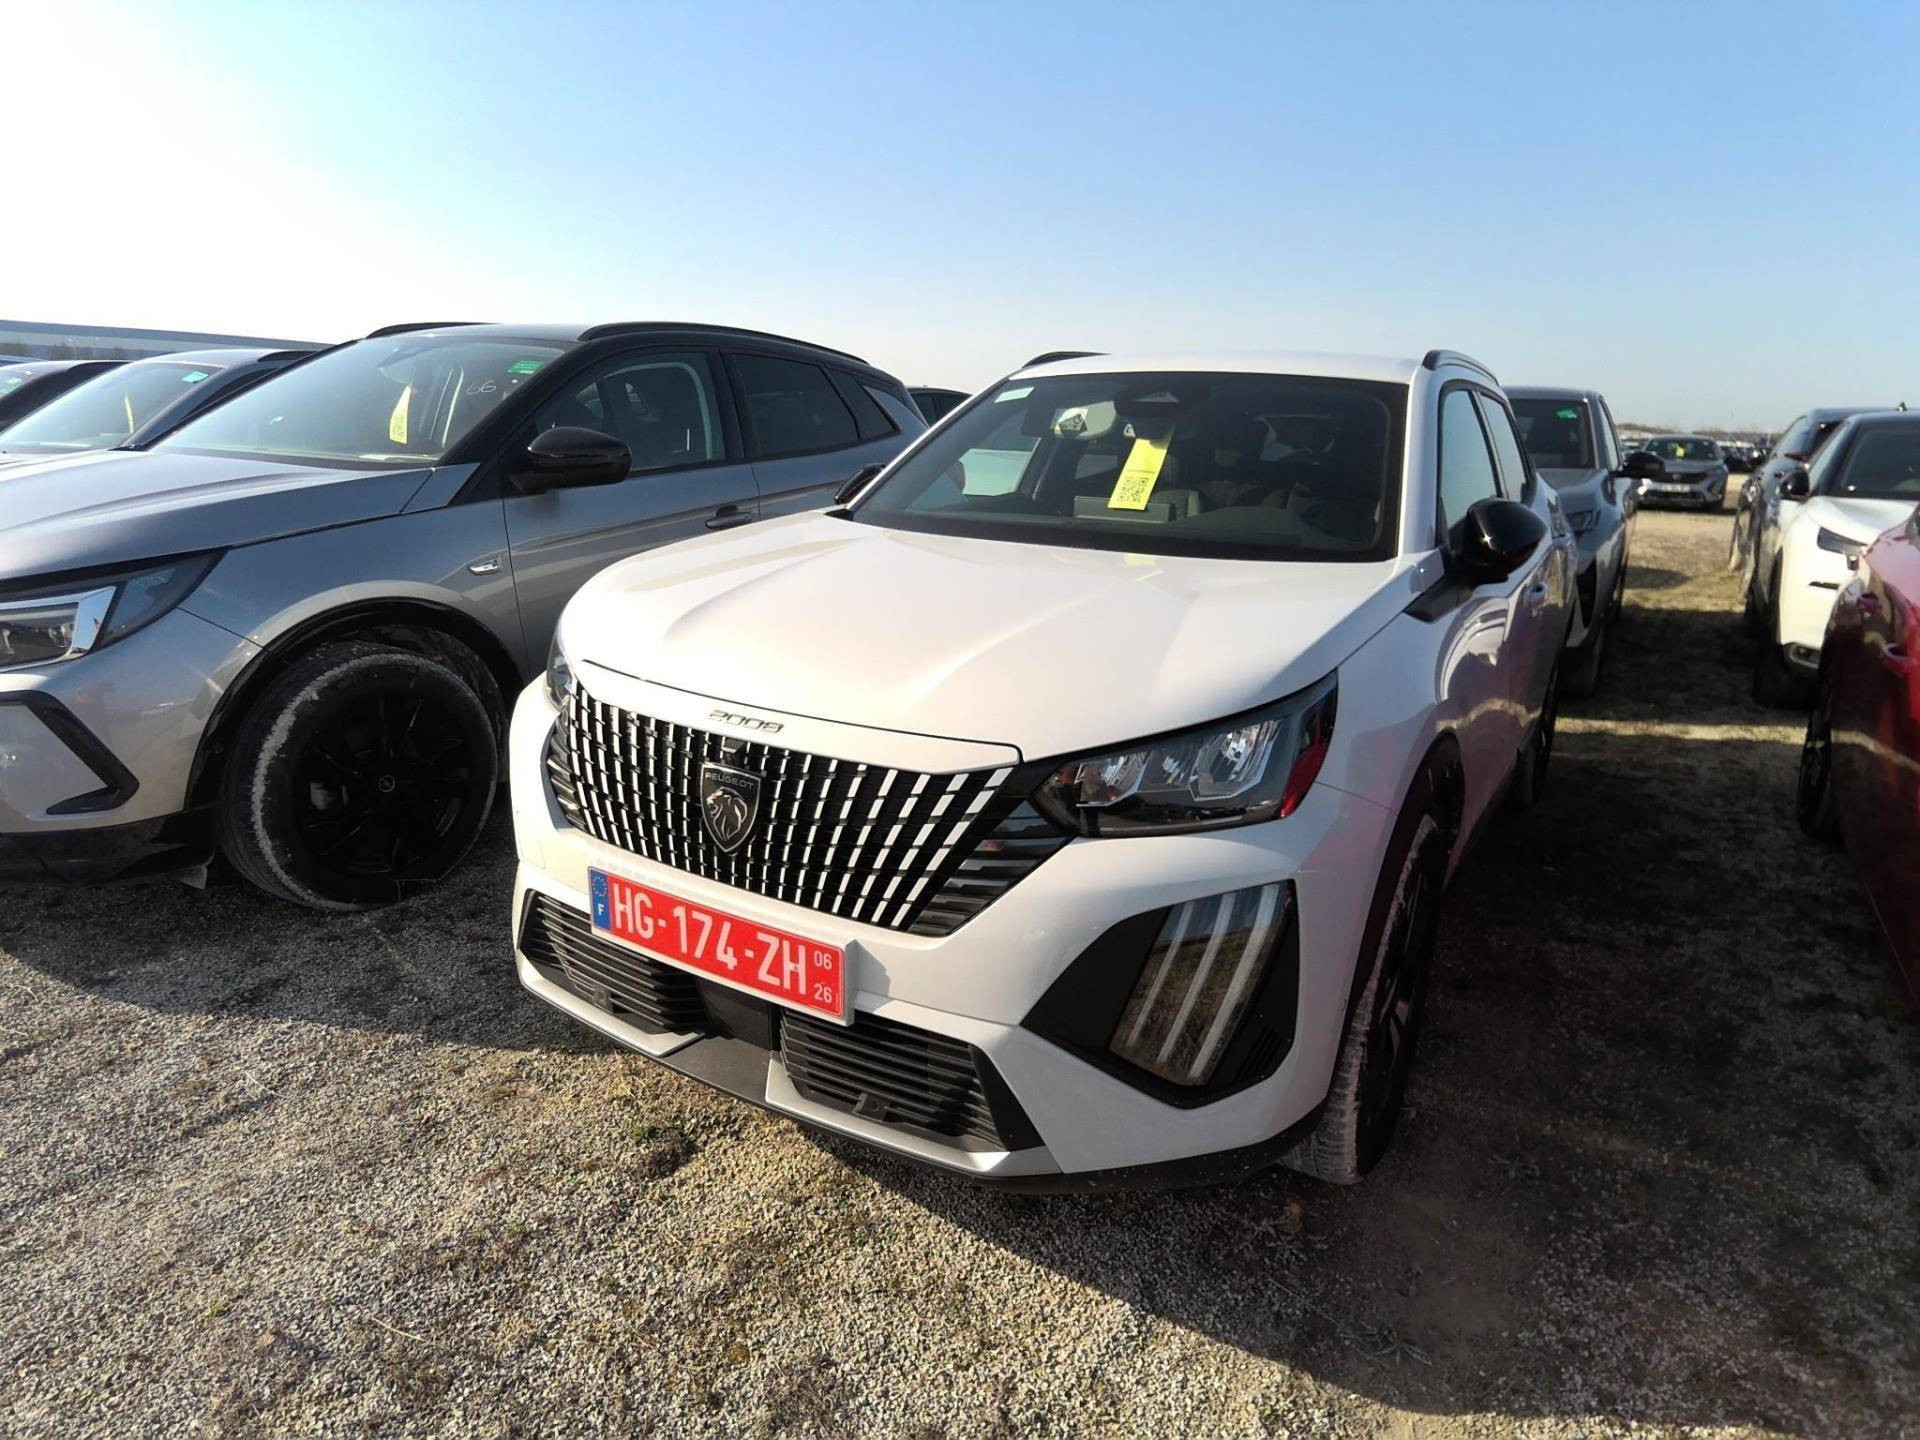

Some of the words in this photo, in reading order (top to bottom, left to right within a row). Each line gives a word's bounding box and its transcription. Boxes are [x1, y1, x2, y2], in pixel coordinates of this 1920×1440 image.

[708, 709, 785, 734] 2008
[705, 771, 755, 789] PEUGEOT
[597, 903, 605, 917] F
[613, 883, 807, 996] HG-174-ZH
[813, 950, 833, 971] 06
[813, 982, 833, 1004] 26
